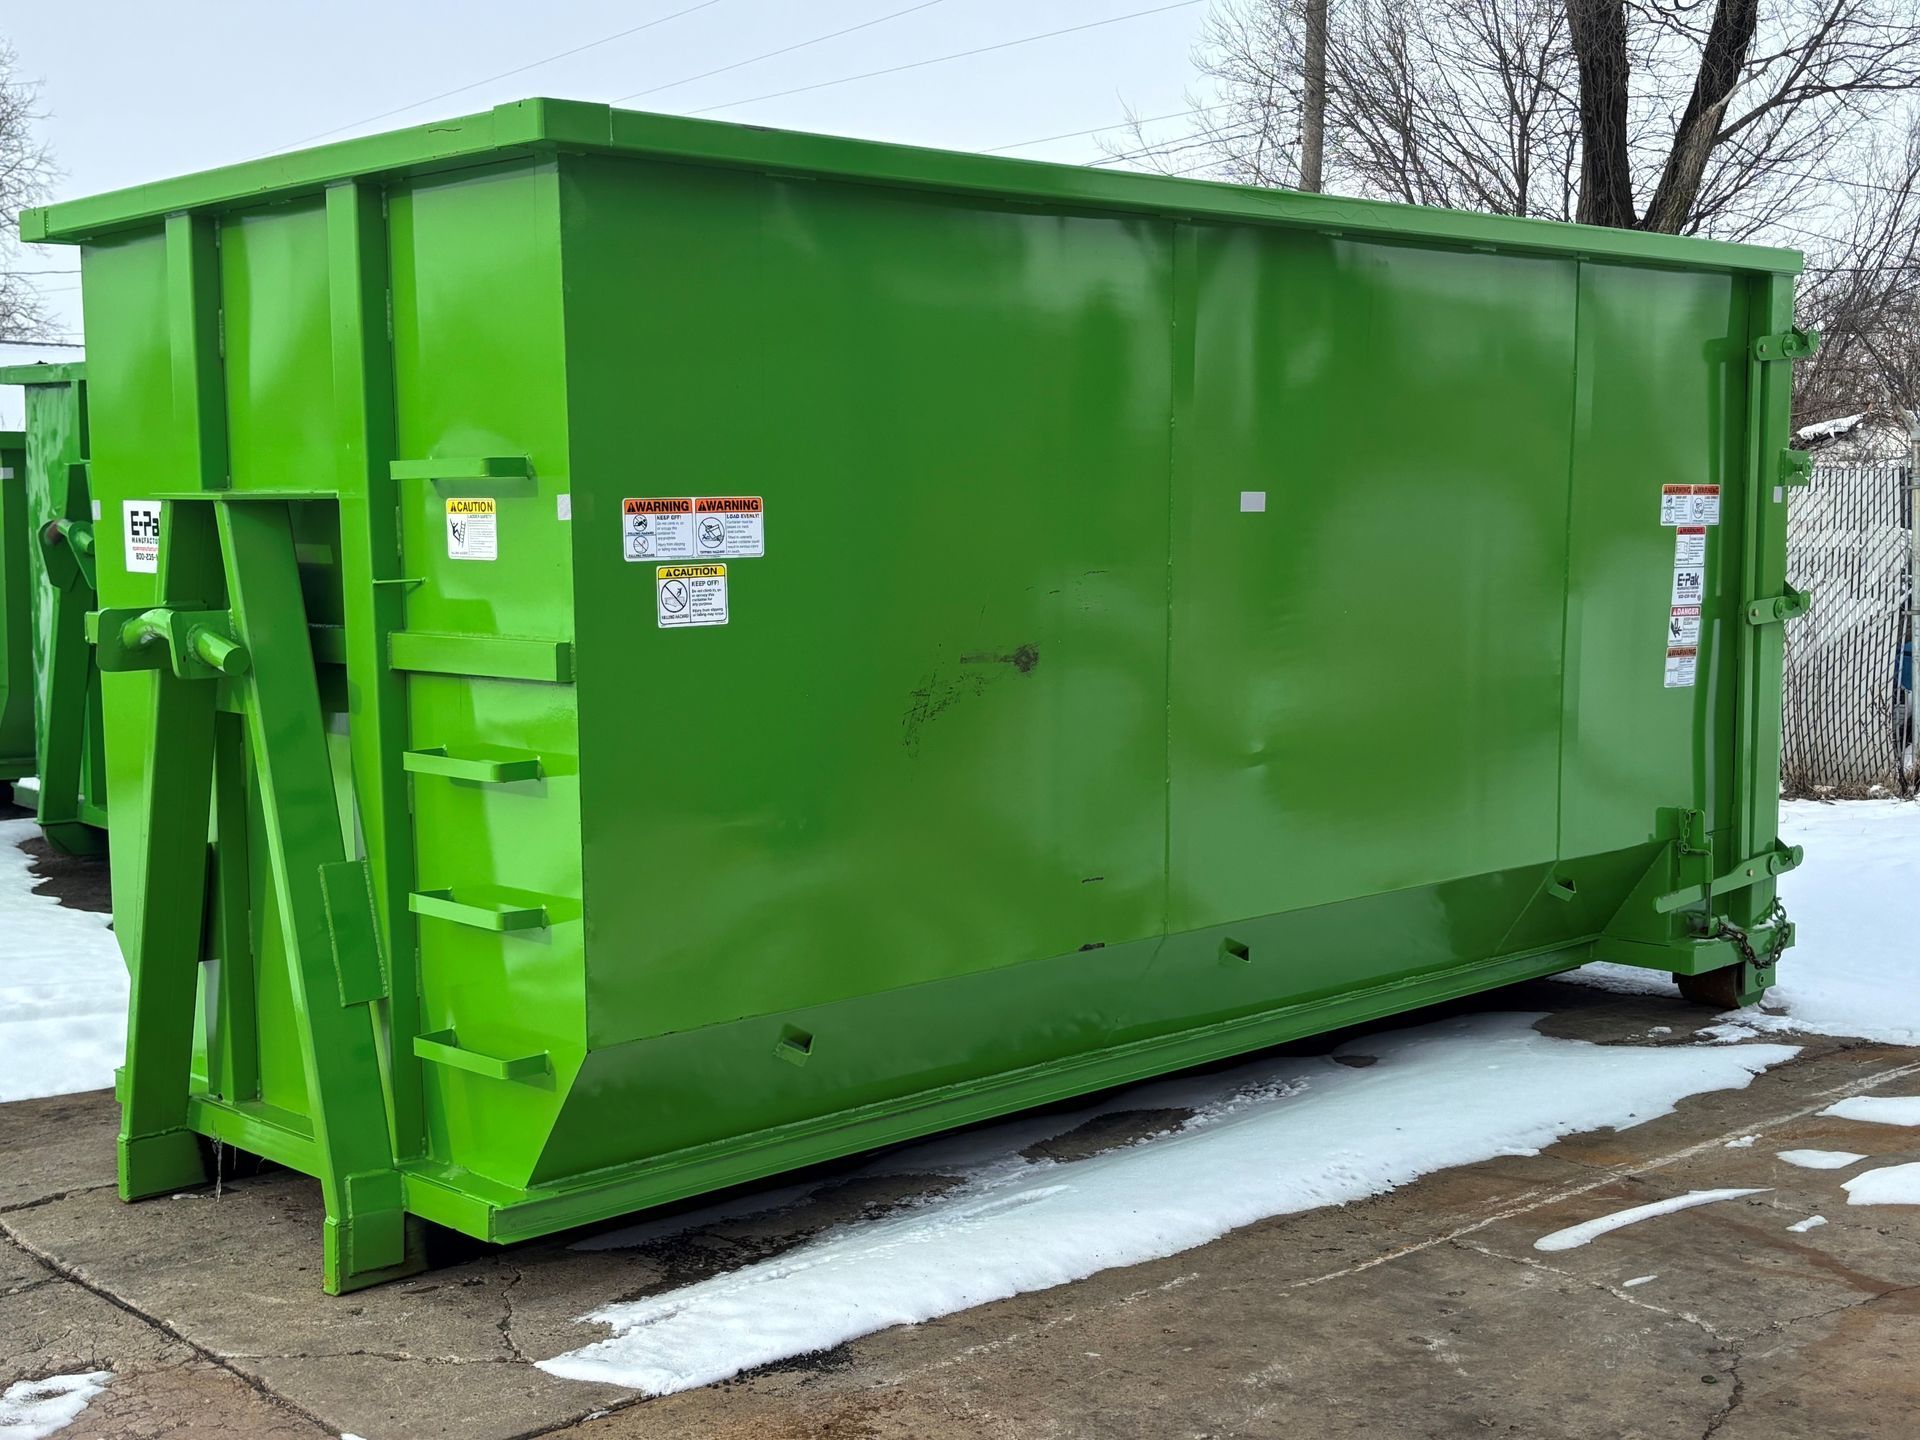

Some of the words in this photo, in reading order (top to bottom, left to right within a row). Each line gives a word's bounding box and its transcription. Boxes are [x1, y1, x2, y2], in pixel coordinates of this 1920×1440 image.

[457, 502, 492, 512] CAUTION
[636, 501, 689, 512] WARNING
[706, 500, 758, 510] WARNING
[131, 511, 160, 536] E-Pa
[673, 568, 717, 576] CAUTION
[1678, 572, 1699, 586] E-Pak
